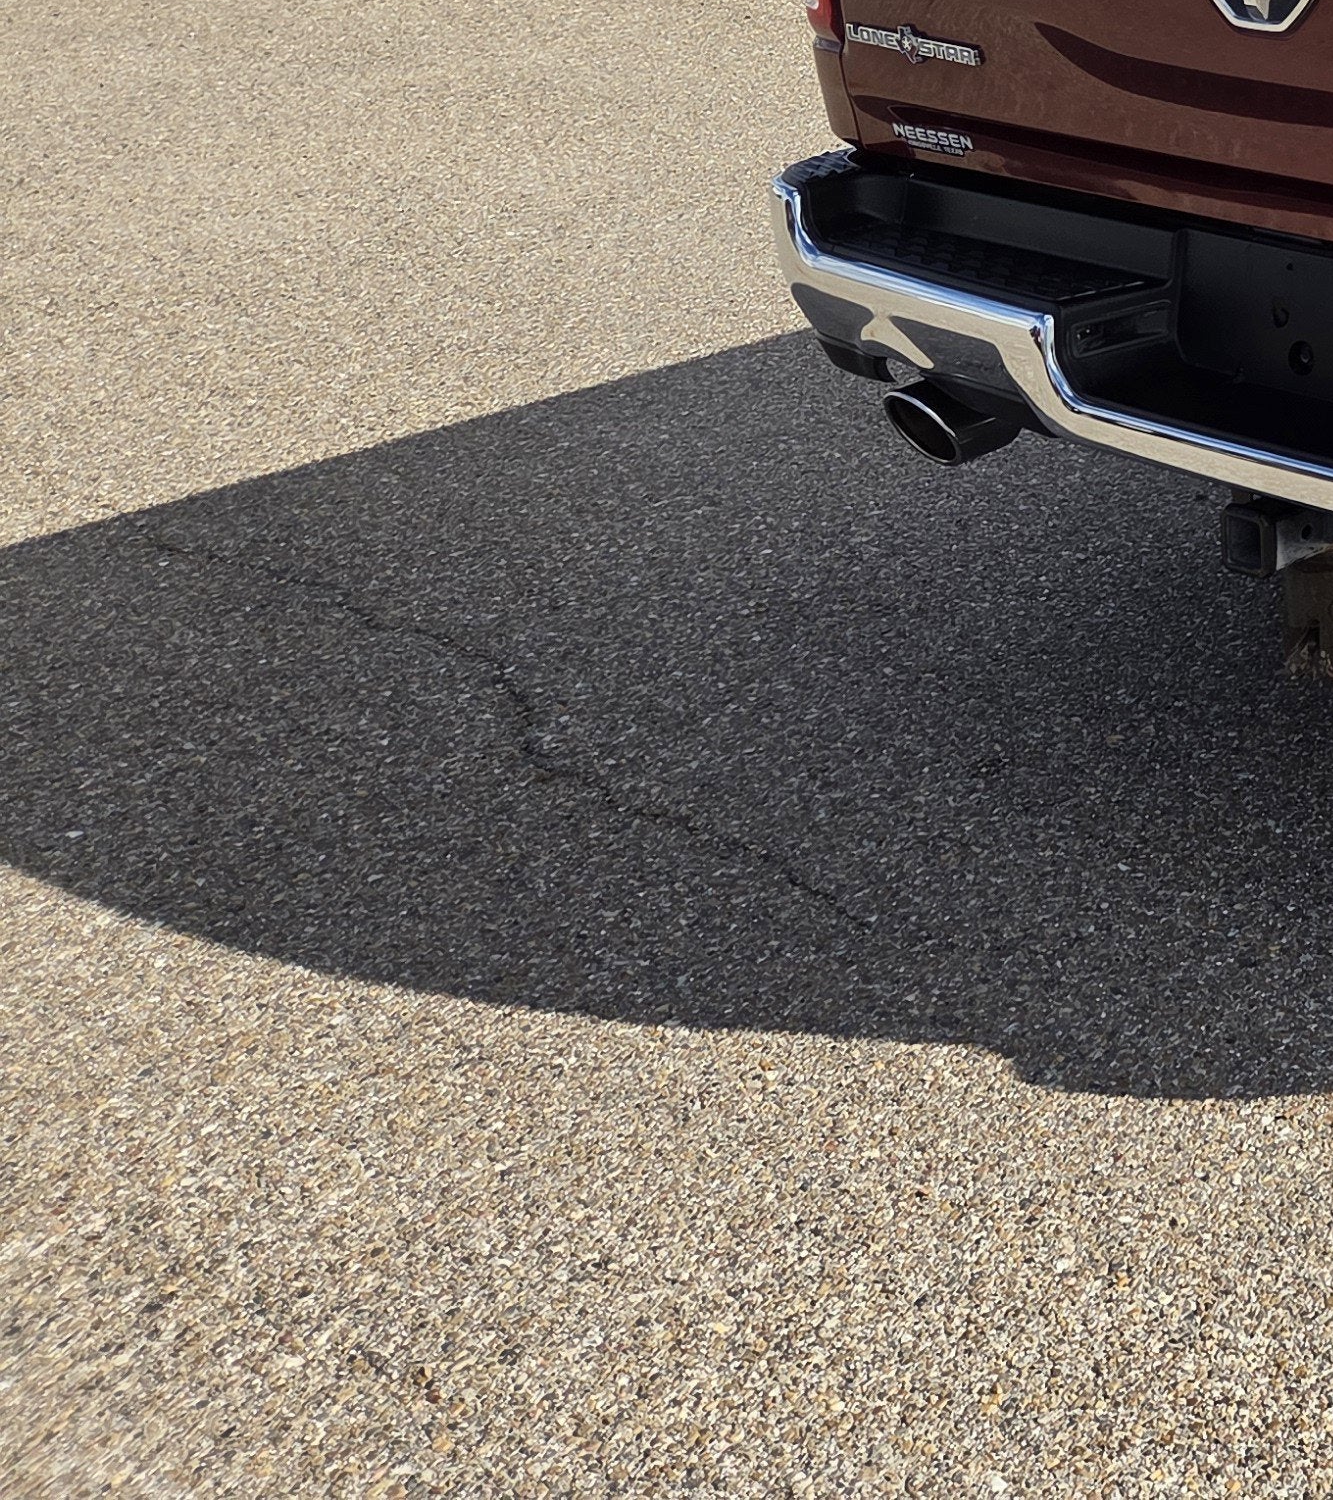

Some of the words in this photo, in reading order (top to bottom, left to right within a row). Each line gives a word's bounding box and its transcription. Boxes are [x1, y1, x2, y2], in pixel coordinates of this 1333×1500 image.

[845, 22, 901, 51] LONE
[916, 37, 978, 66] STAR
[892, 122, 974, 150] NEESSEN
